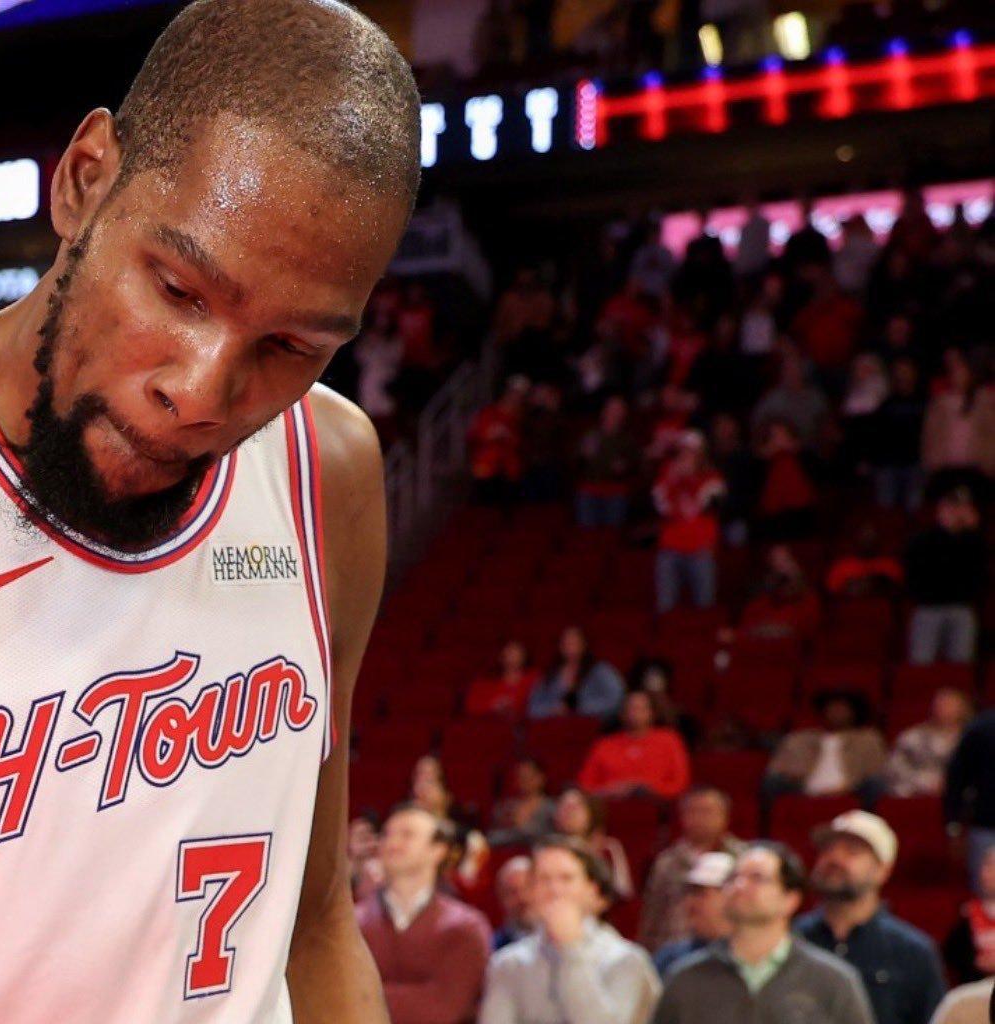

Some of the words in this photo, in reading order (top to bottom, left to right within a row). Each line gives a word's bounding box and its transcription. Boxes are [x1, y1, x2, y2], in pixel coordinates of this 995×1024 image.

[212, 545, 297, 563] MEMORIAL
[213, 561, 297, 580] HERMANN
[175, 832, 272, 1000] 7
